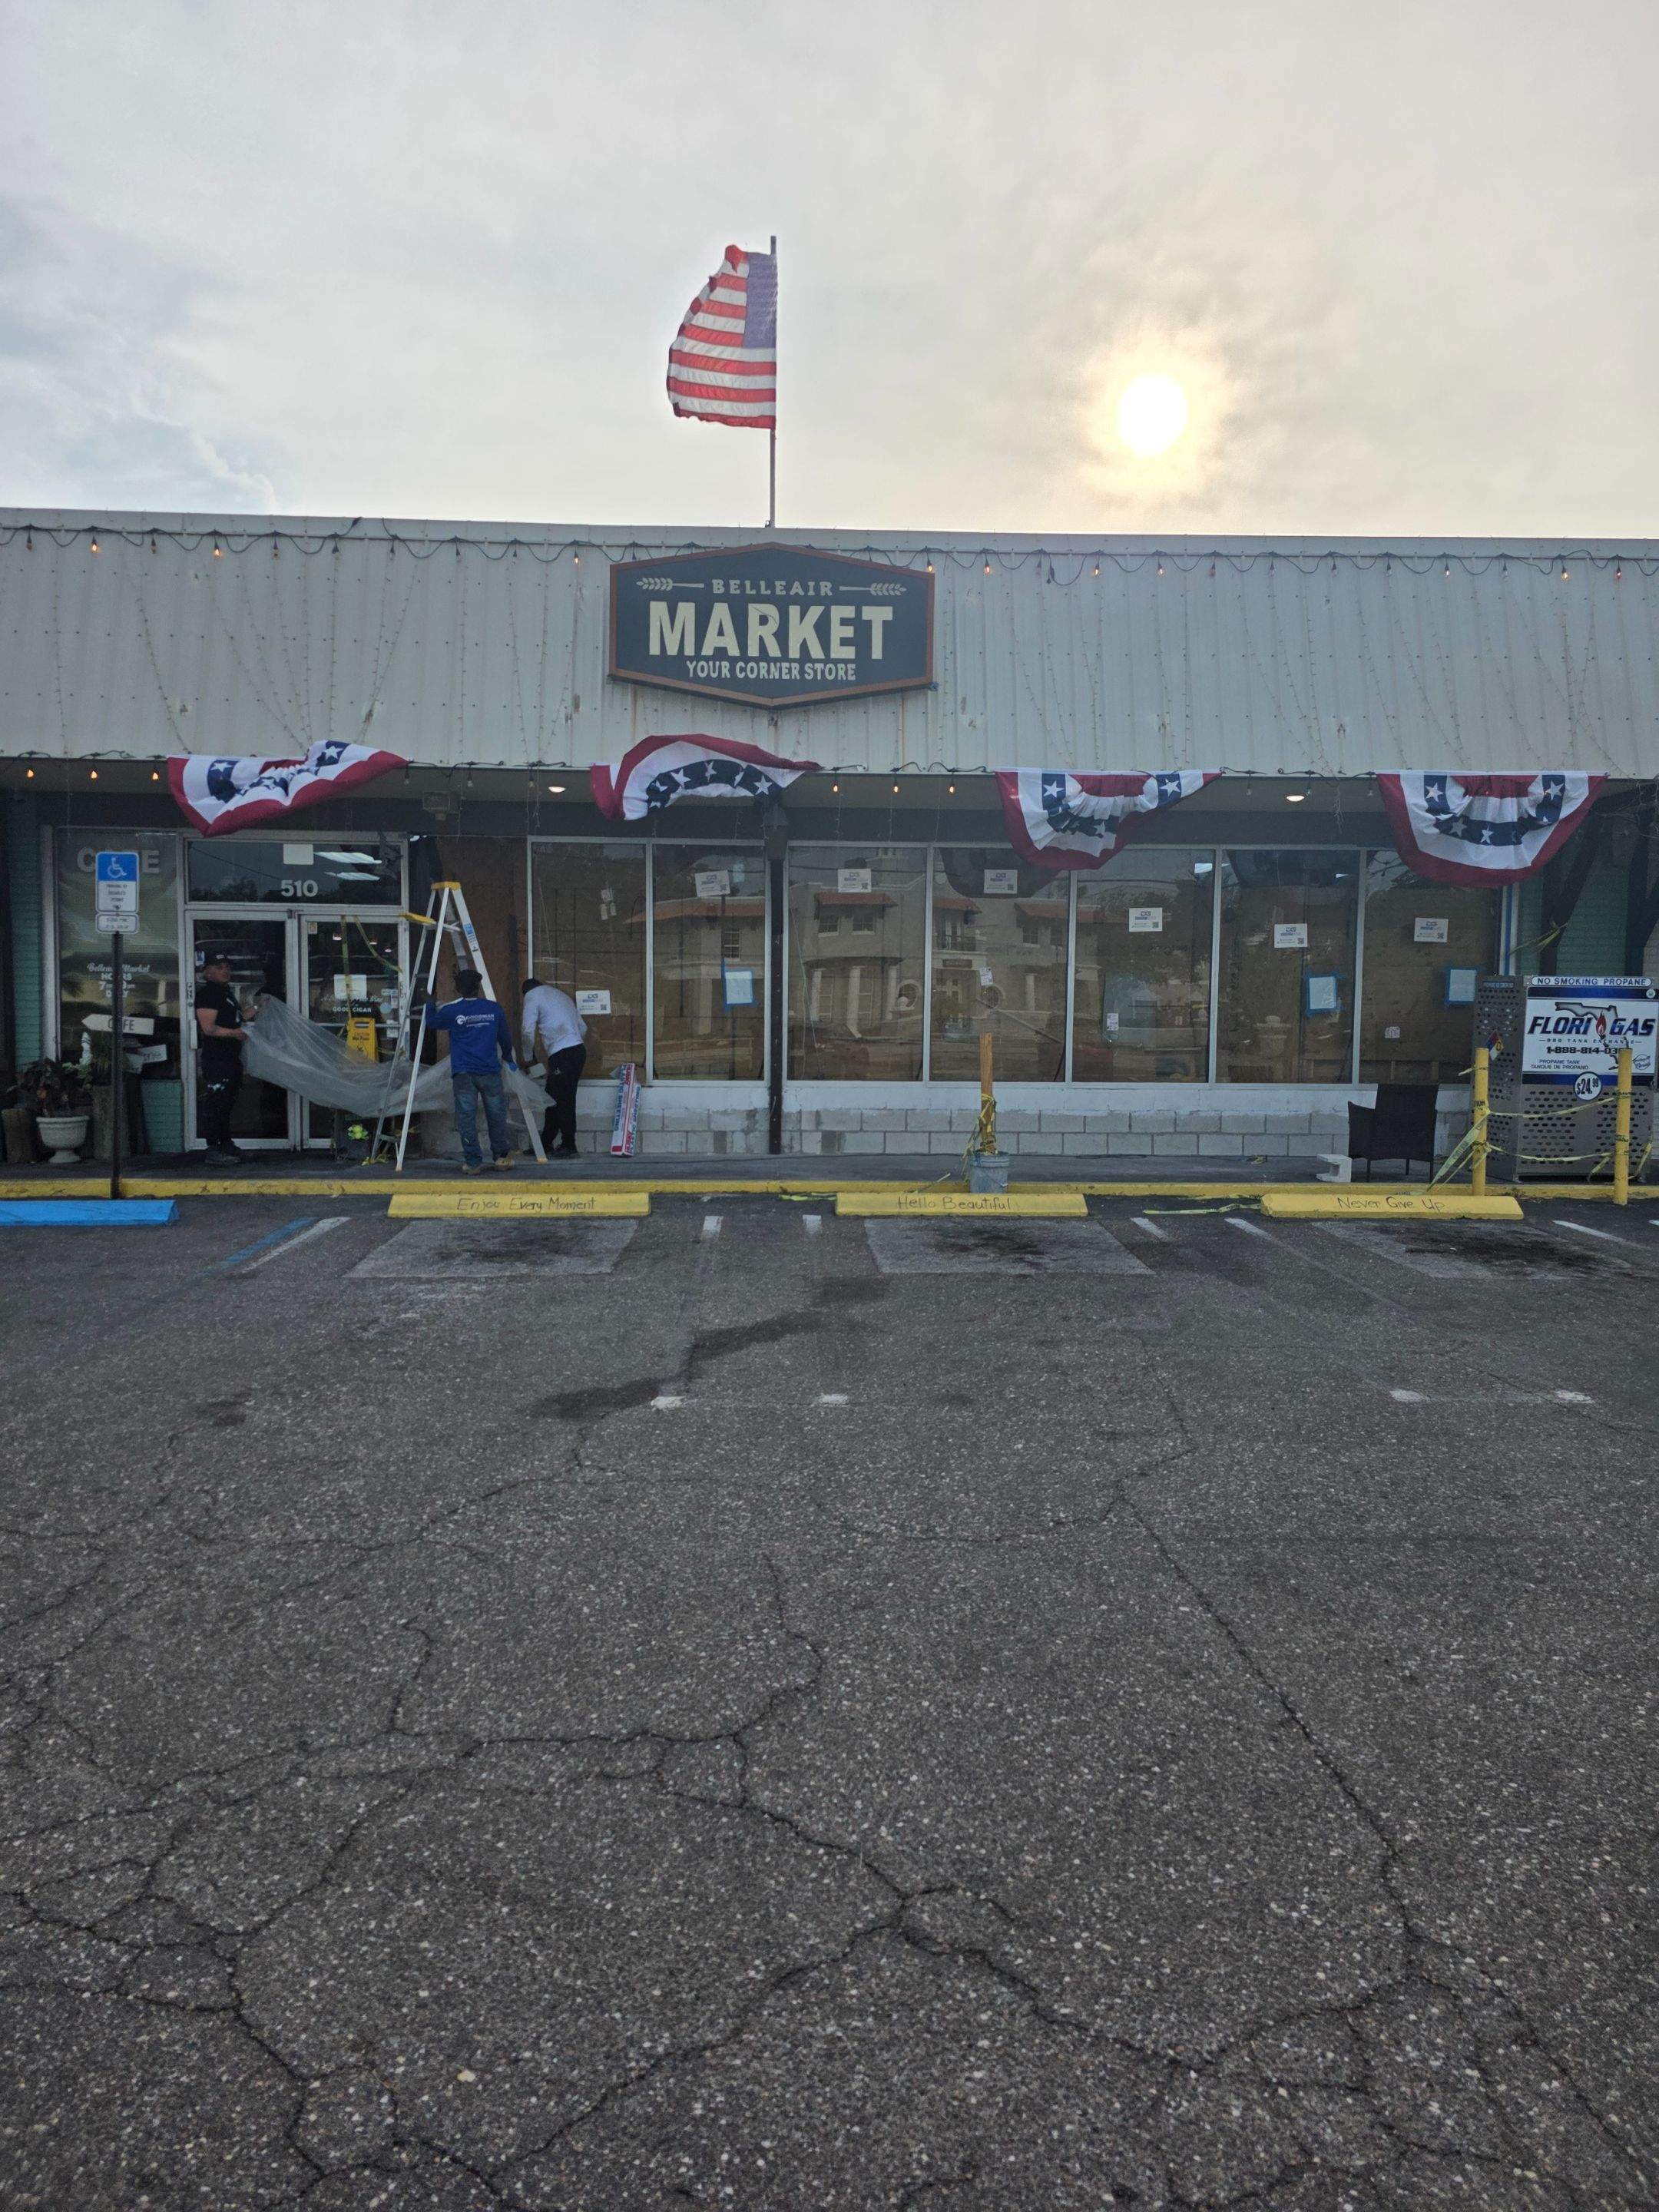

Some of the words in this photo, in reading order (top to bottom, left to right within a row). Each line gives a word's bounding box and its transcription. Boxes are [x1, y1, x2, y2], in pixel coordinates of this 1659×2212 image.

[712, 578, 833, 596] BELLEAIR
[649, 601, 893, 660] MARKET
[686, 661, 730, 679] YOUR
[735, 661, 800, 680] CORNER
[804, 663, 856, 681] STORE
[77, 846, 160, 873] CE
[281, 879, 319, 897] 510
[1555, 977, 1598, 985] SMOKING
[1604, 978, 1647, 986] PROPANE
[108, 1018, 135, 1031] CFE
[508, 1197, 542, 1214] Every
[548, 1197, 596, 1211] Moment
[898, 1196, 935, 1210] Hello
[942, 1196, 1011, 1210] Beautiful
[1337, 1197, 1381, 1210] Never
[1386, 1196, 1414, 1210] Give
[1421, 1198, 1445, 1213] Up
